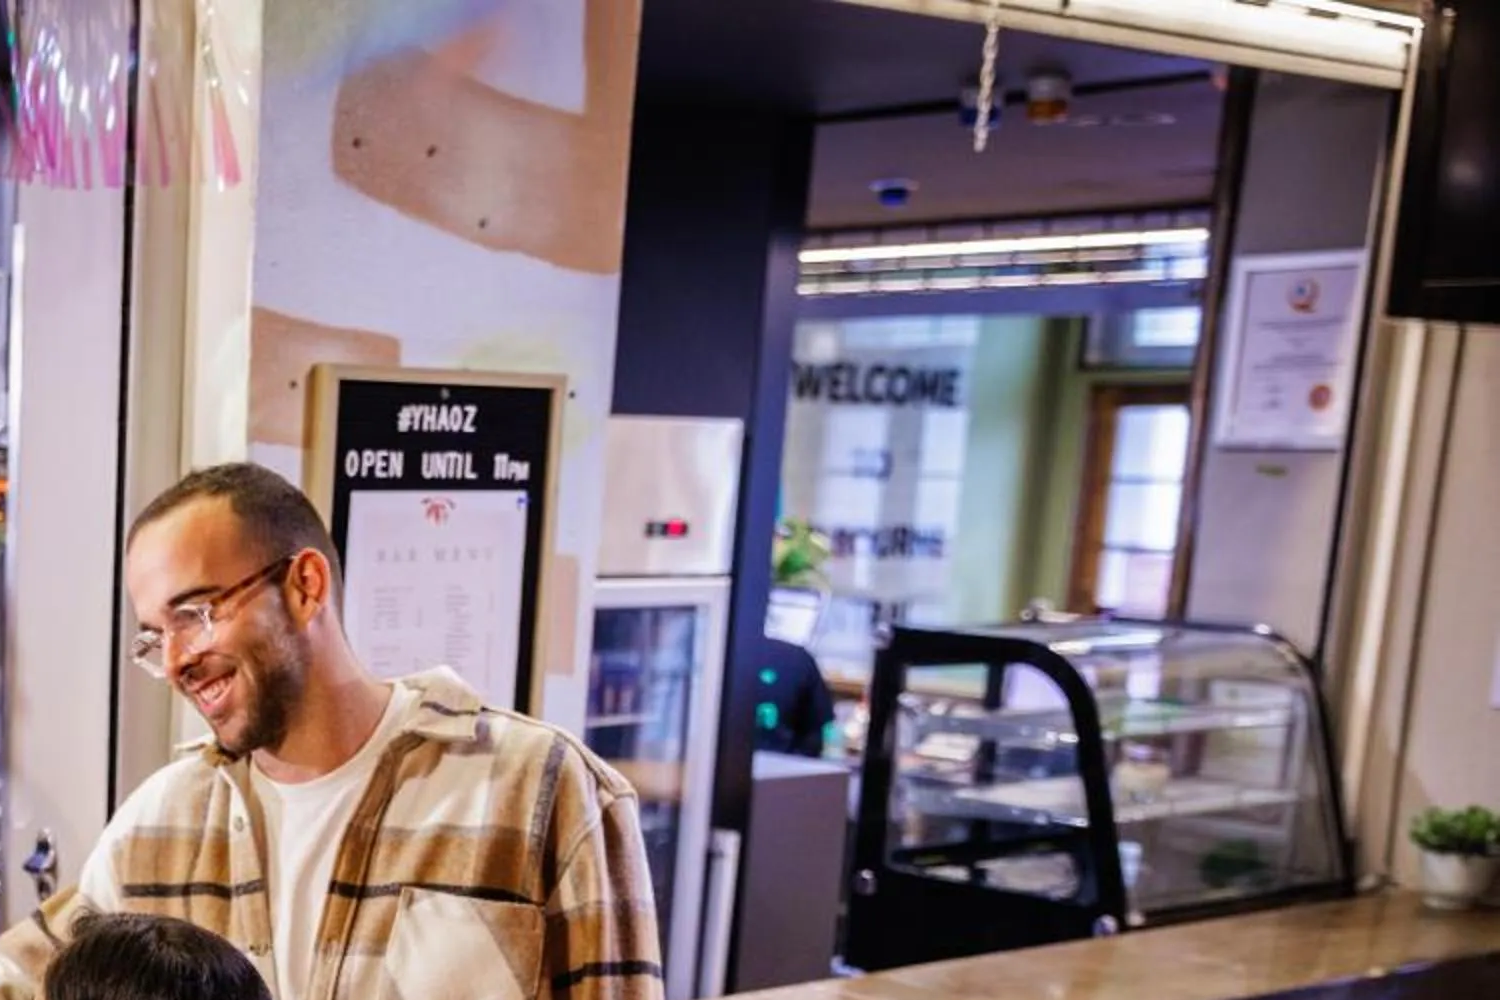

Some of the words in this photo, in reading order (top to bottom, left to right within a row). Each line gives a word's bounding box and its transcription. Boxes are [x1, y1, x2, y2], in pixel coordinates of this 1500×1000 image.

[791, 361, 962, 408] WELCOME
[344, 449, 405, 479] OPEN
[421, 451, 479, 480] UNTIL
